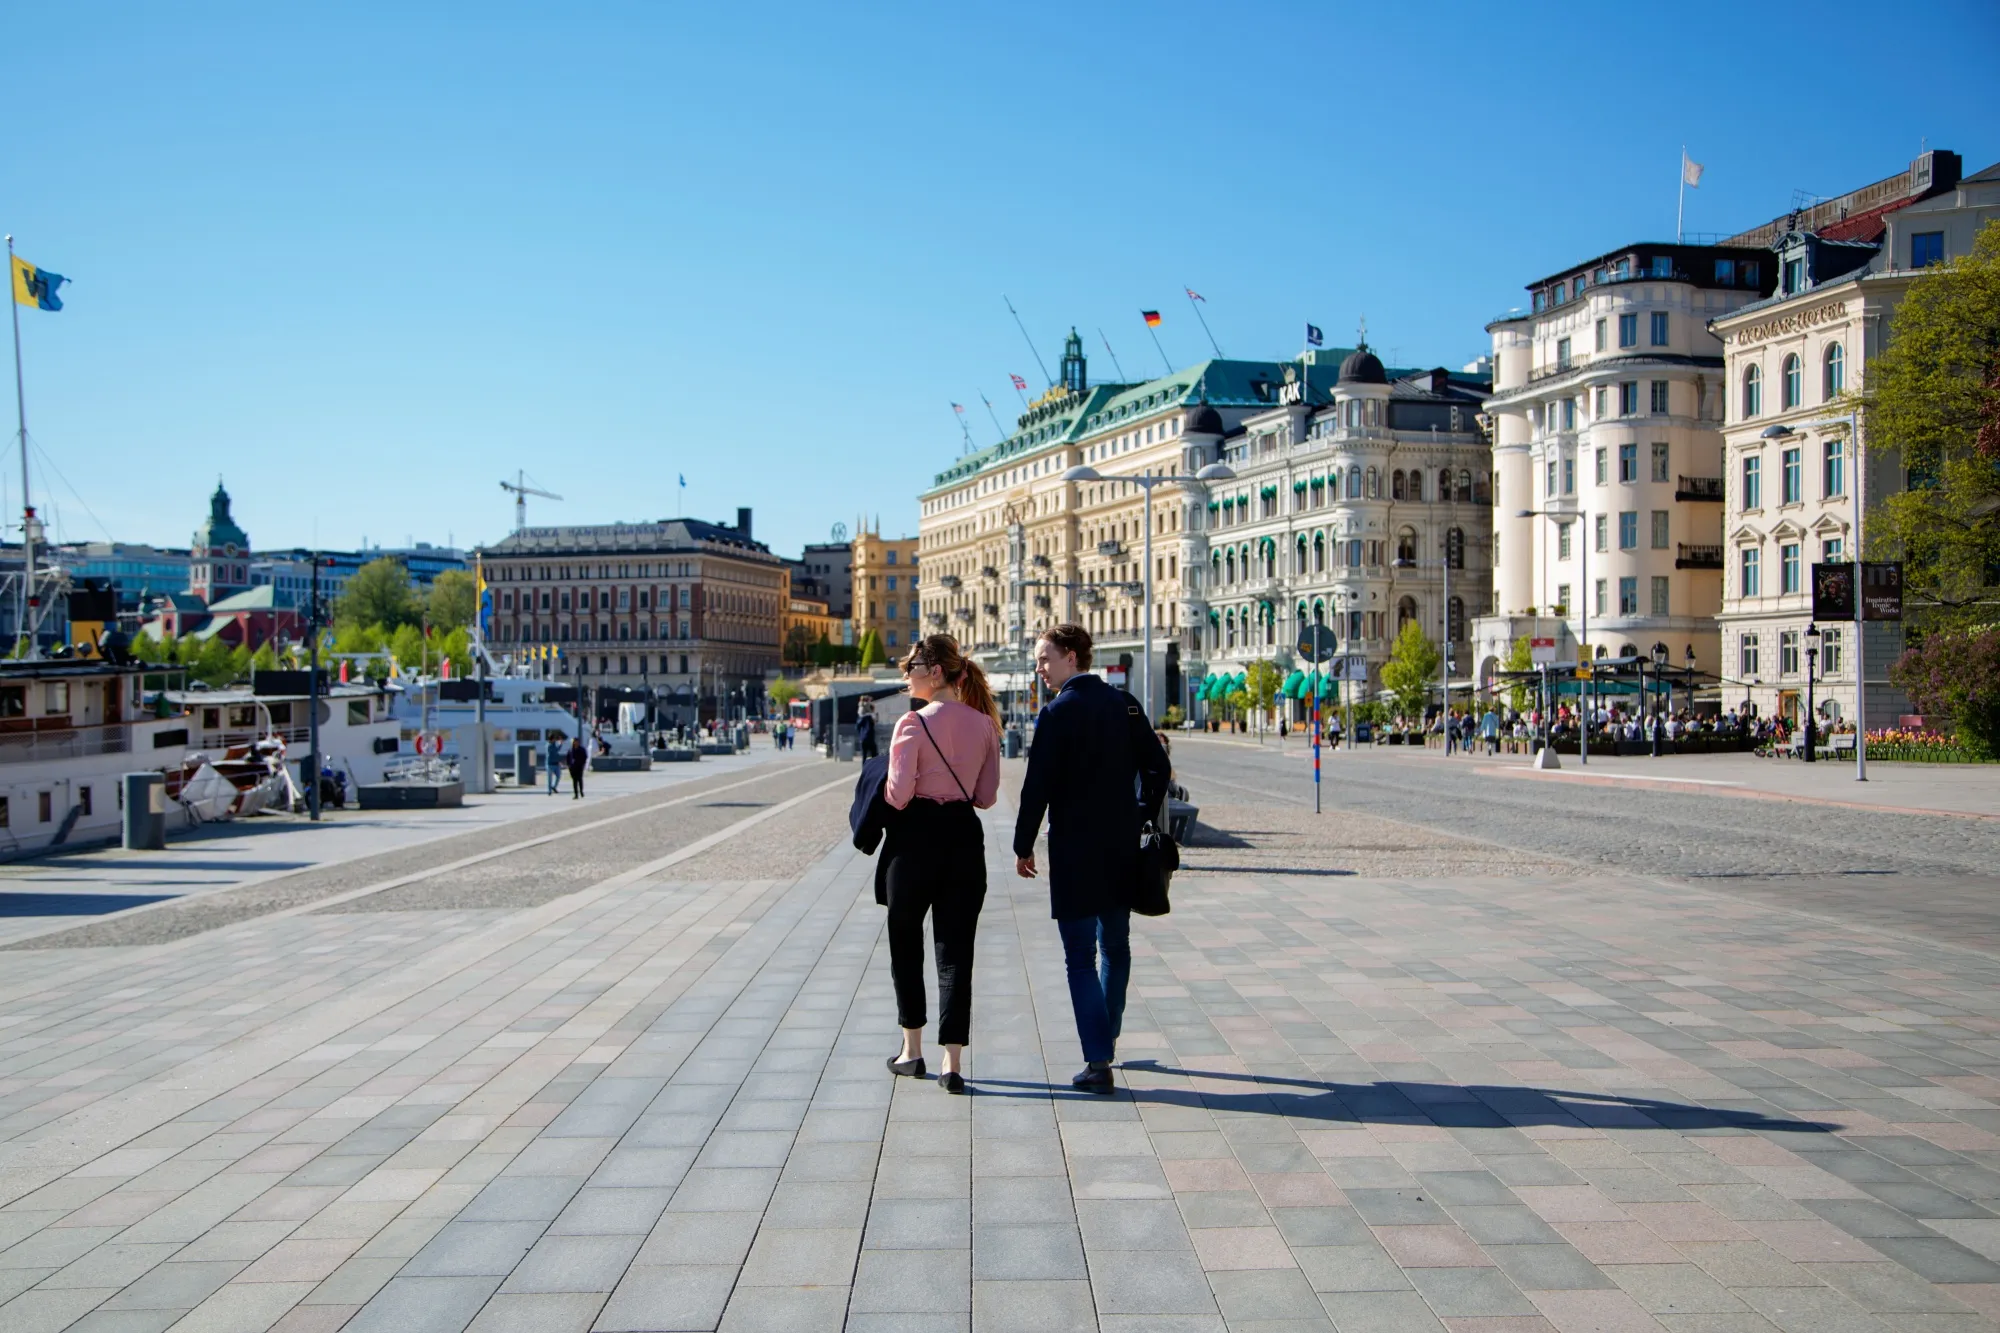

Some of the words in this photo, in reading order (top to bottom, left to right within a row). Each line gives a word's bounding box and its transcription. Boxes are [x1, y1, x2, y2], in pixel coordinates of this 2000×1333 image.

[1797, 301, 1848, 329] HOTEL
[1279, 381, 1300, 406] KAK
[1865, 596, 1899, 605] Inspiration
